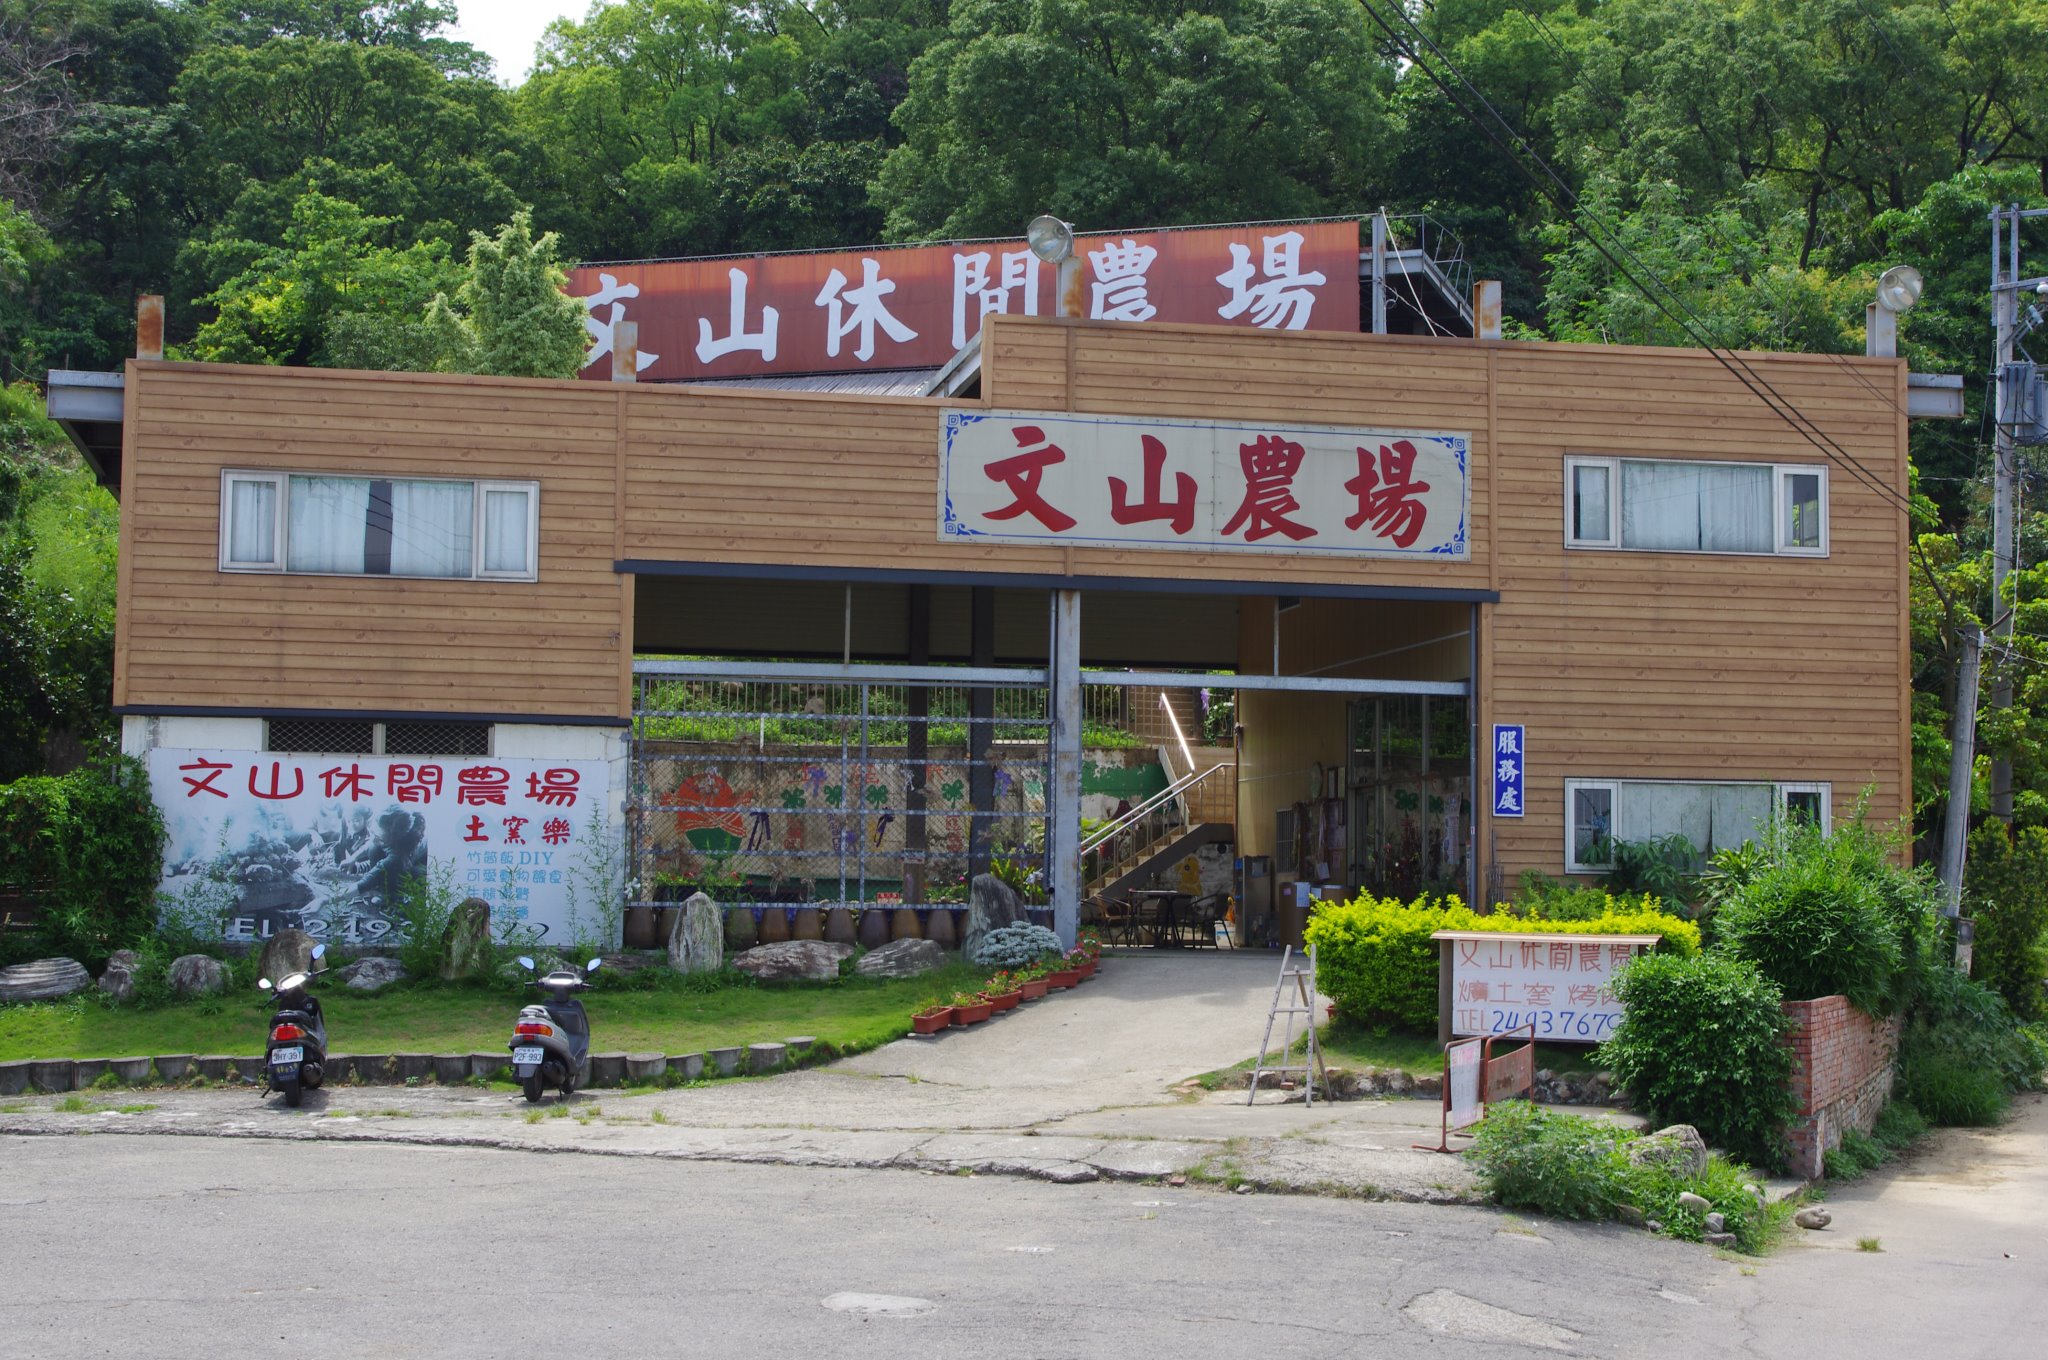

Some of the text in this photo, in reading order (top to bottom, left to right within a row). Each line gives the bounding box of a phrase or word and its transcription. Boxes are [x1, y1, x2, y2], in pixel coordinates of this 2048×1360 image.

[982, 426, 1431, 548] 文山農場
[1497, 731, 1521, 811] 服務處
[463, 815, 570, 846] 土窯樂
[1457, 1009, 1489, 1032] TEL
